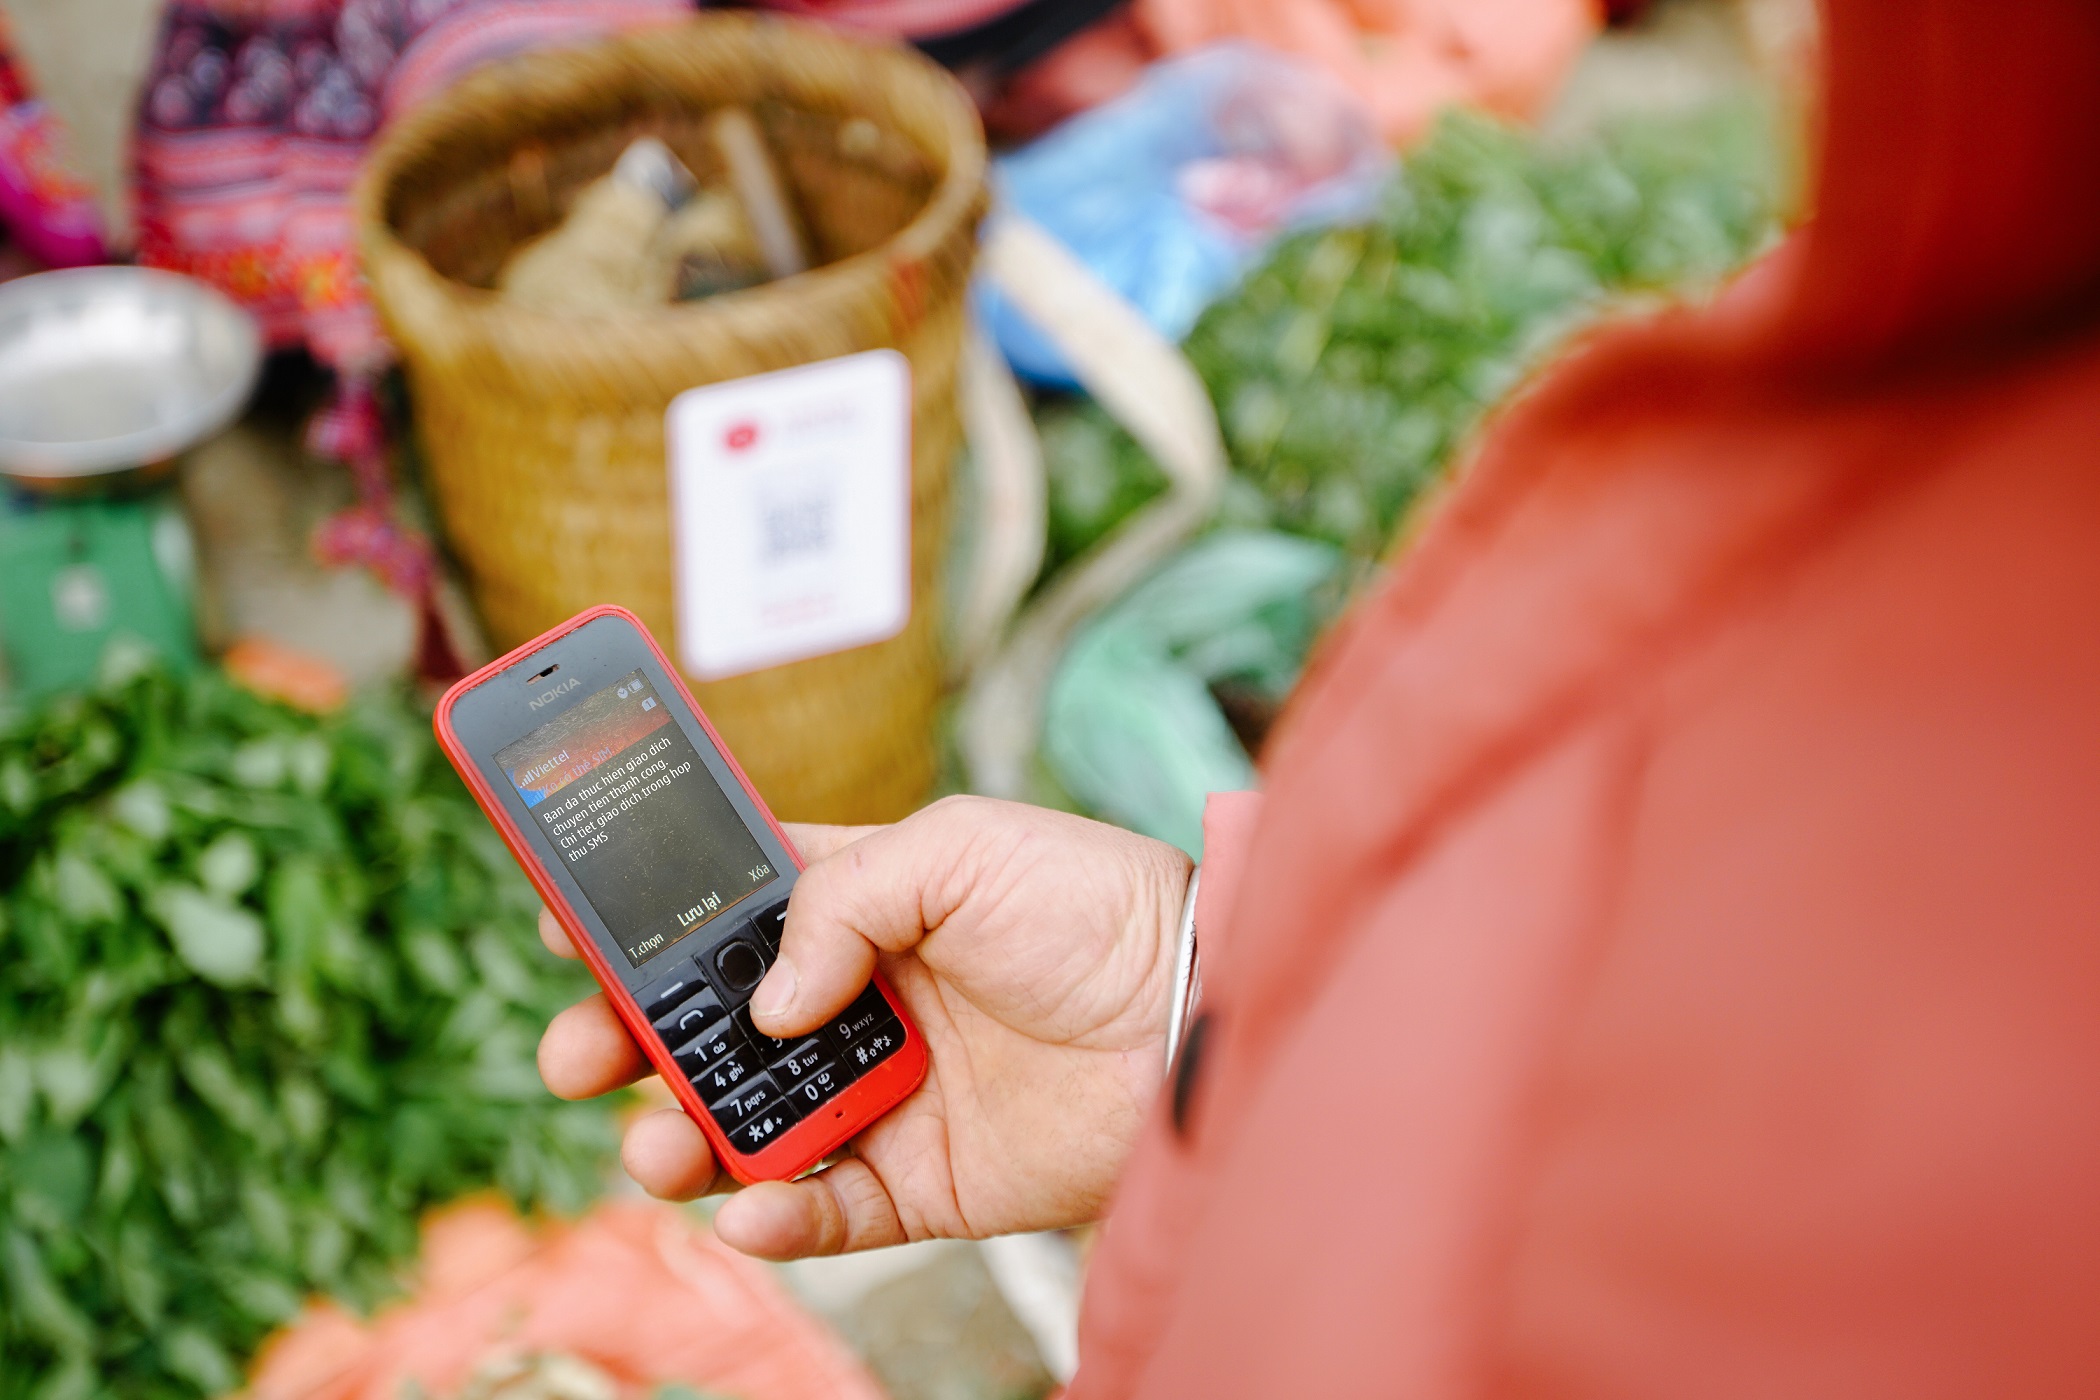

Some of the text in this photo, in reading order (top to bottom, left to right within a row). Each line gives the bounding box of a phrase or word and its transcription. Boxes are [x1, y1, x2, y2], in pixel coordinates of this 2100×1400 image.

[529, 677, 582, 711] NOKIA
[532, 750, 570, 779] Viettel
[592, 747, 613, 764] SIM
[543, 737, 672, 824] Ban da thuc hien giao dich
[553, 759, 669, 836] chuyen tien thanh cong.
[560, 761, 691, 849] Chi tiet giao dich trong hop
[568, 831, 608, 862] thu SMS
[747, 863, 770, 883] Xóa
[676, 891, 722, 927] Lưu lại
[628, 932, 664, 960] T.chọn
[838, 1012, 874, 1039] 9 wxyz
[694, 1046, 708, 1062] 1
[787, 1052, 818, 1076] 8 tuv
[714, 1071, 727, 1087] 4
[804, 1083, 819, 1101] 0
[730, 1090, 766, 1117] 7 pqrs
